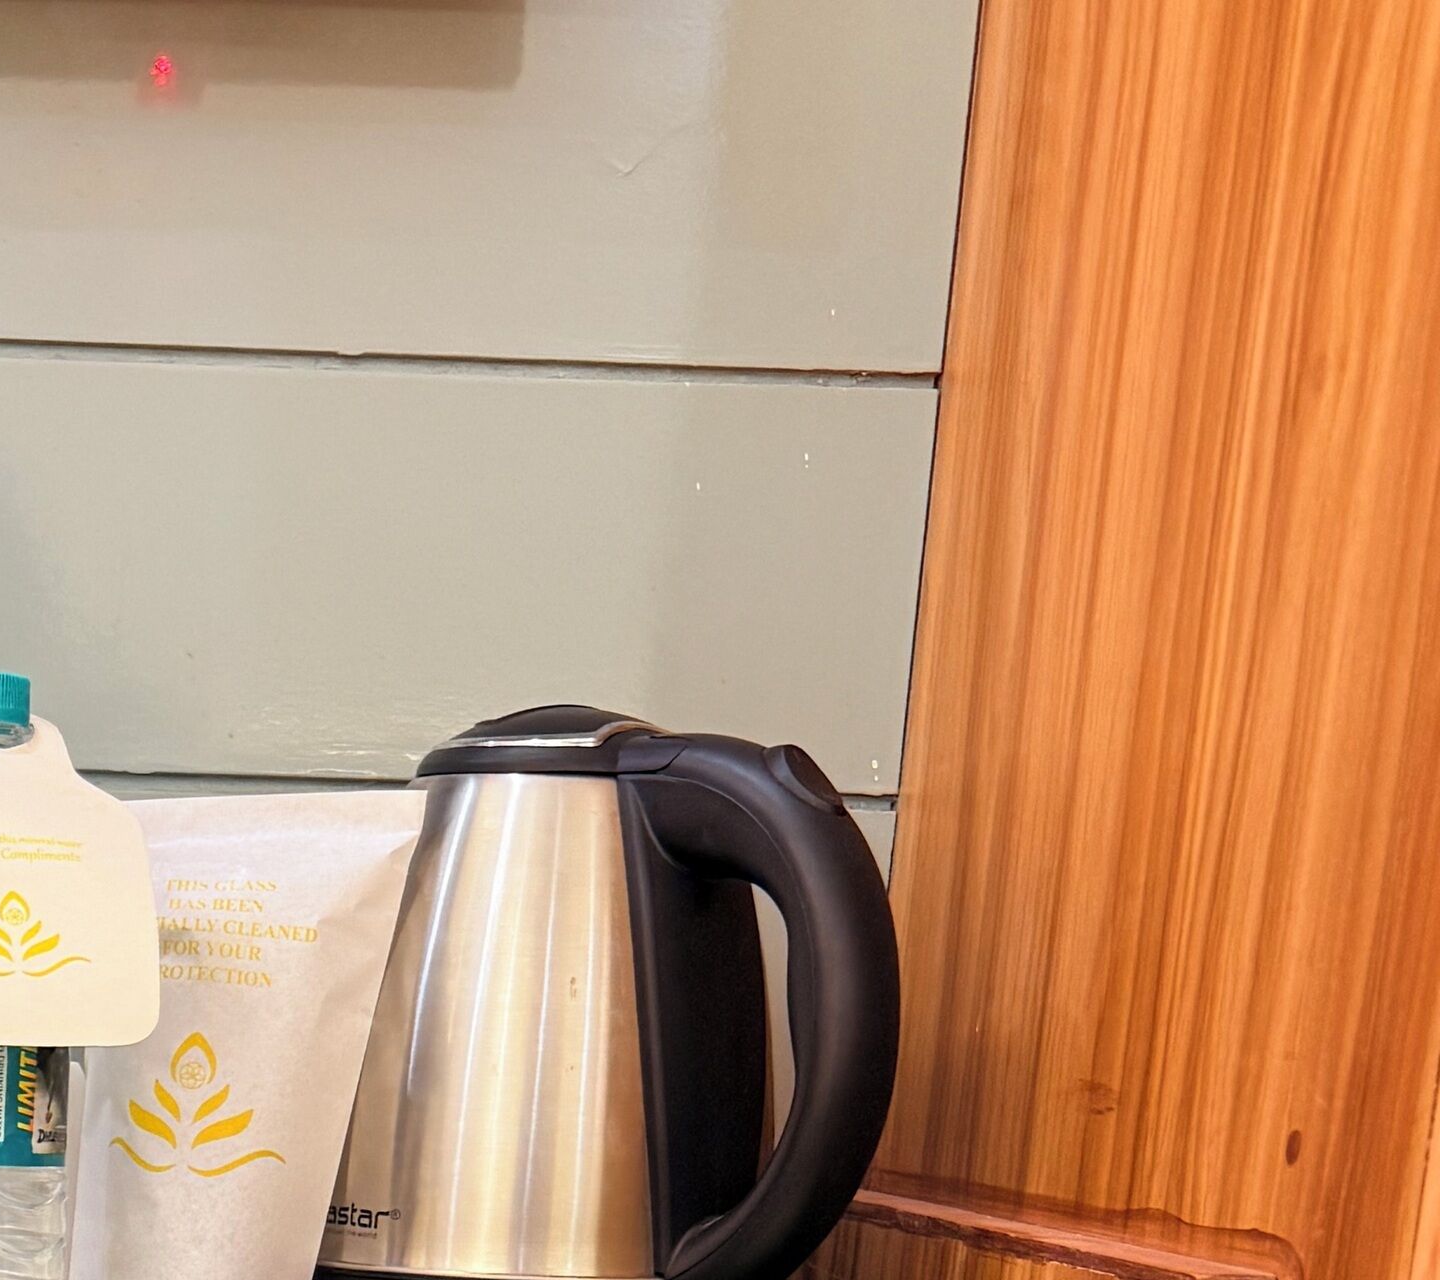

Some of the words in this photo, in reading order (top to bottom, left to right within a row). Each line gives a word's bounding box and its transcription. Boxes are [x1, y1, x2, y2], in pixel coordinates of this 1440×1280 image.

[0, 846, 82, 864] Compliments
[165, 878, 209, 892] THIS
[214, 878, 278, 892] GLASS
[168, 898, 207, 911] HAS
[213, 898, 265, 913] BEEN
[156, 915, 217, 933] IALLY
[223, 918, 319, 944] CLEANED
[161, 939, 200, 956] FOR
[207, 941, 263, 961] YOUR
[160, 965, 272, 988] ROTECTION
[17, 1046, 38, 1133] LIMIT
